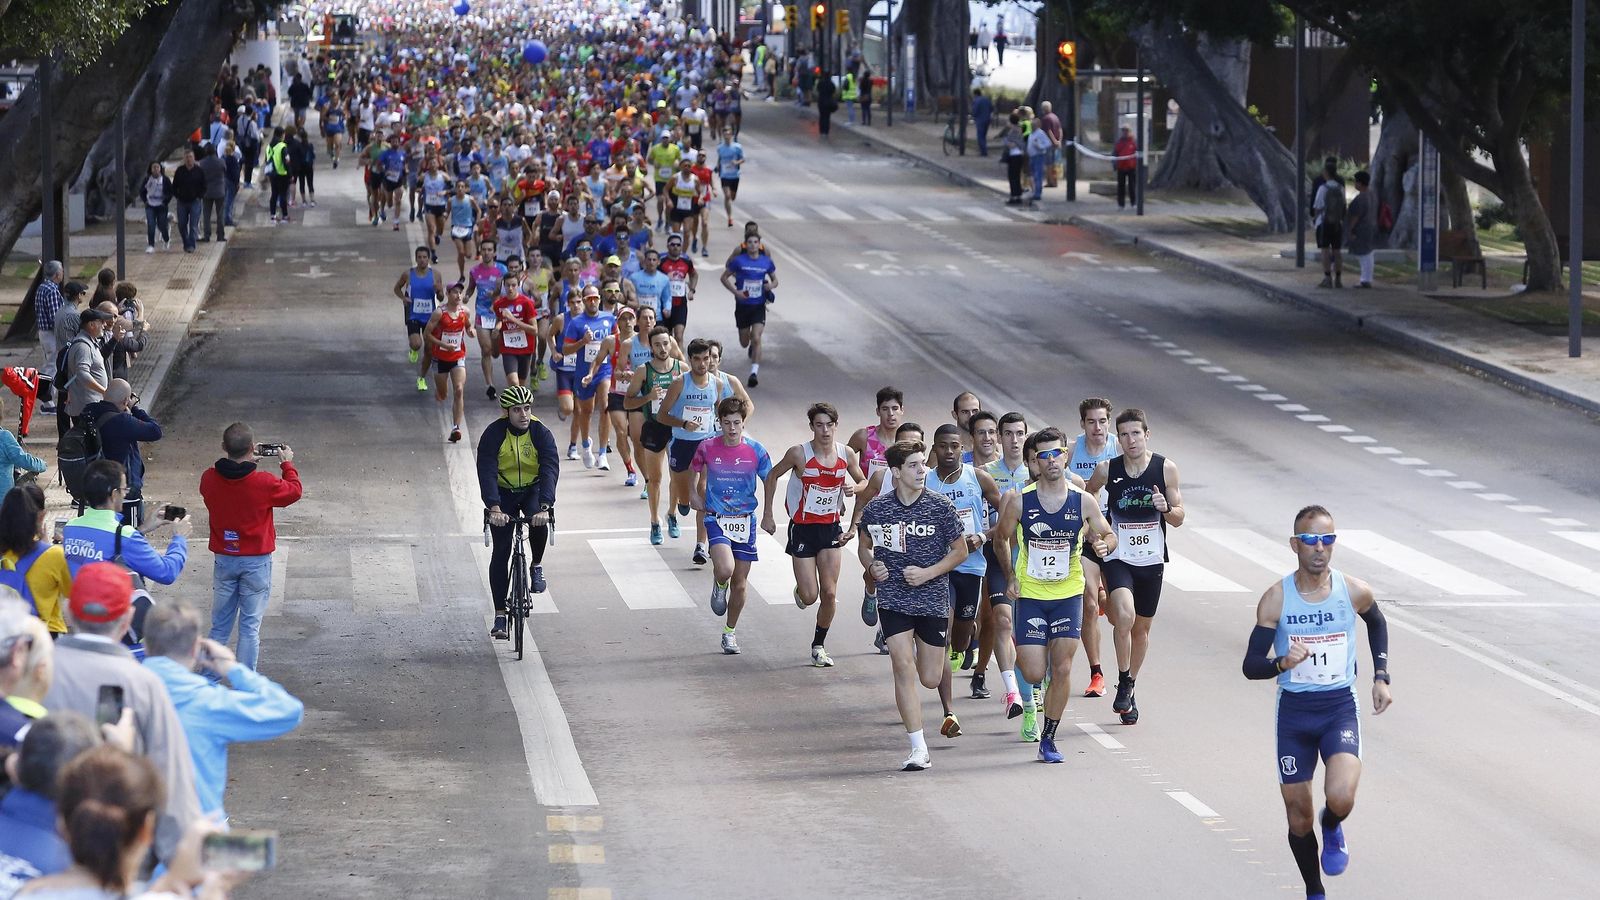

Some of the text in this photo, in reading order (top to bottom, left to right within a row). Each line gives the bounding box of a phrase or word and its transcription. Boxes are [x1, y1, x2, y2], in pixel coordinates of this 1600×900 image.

[686, 393, 708, 401] nerja
[1076, 461, 1097, 471] nerj
[815, 496, 833, 506] 285
[723, 522, 746, 533] 1093
[881, 523, 893, 548] 3328
[1050, 530, 1075, 538] Unicaja
[1129, 534, 1150, 546] 386
[64, 544, 104, 562] RONDA
[1041, 556, 1056, 566] 12
[1286, 610, 1335, 626] nerja
[1310, 652, 1329, 667] 11
